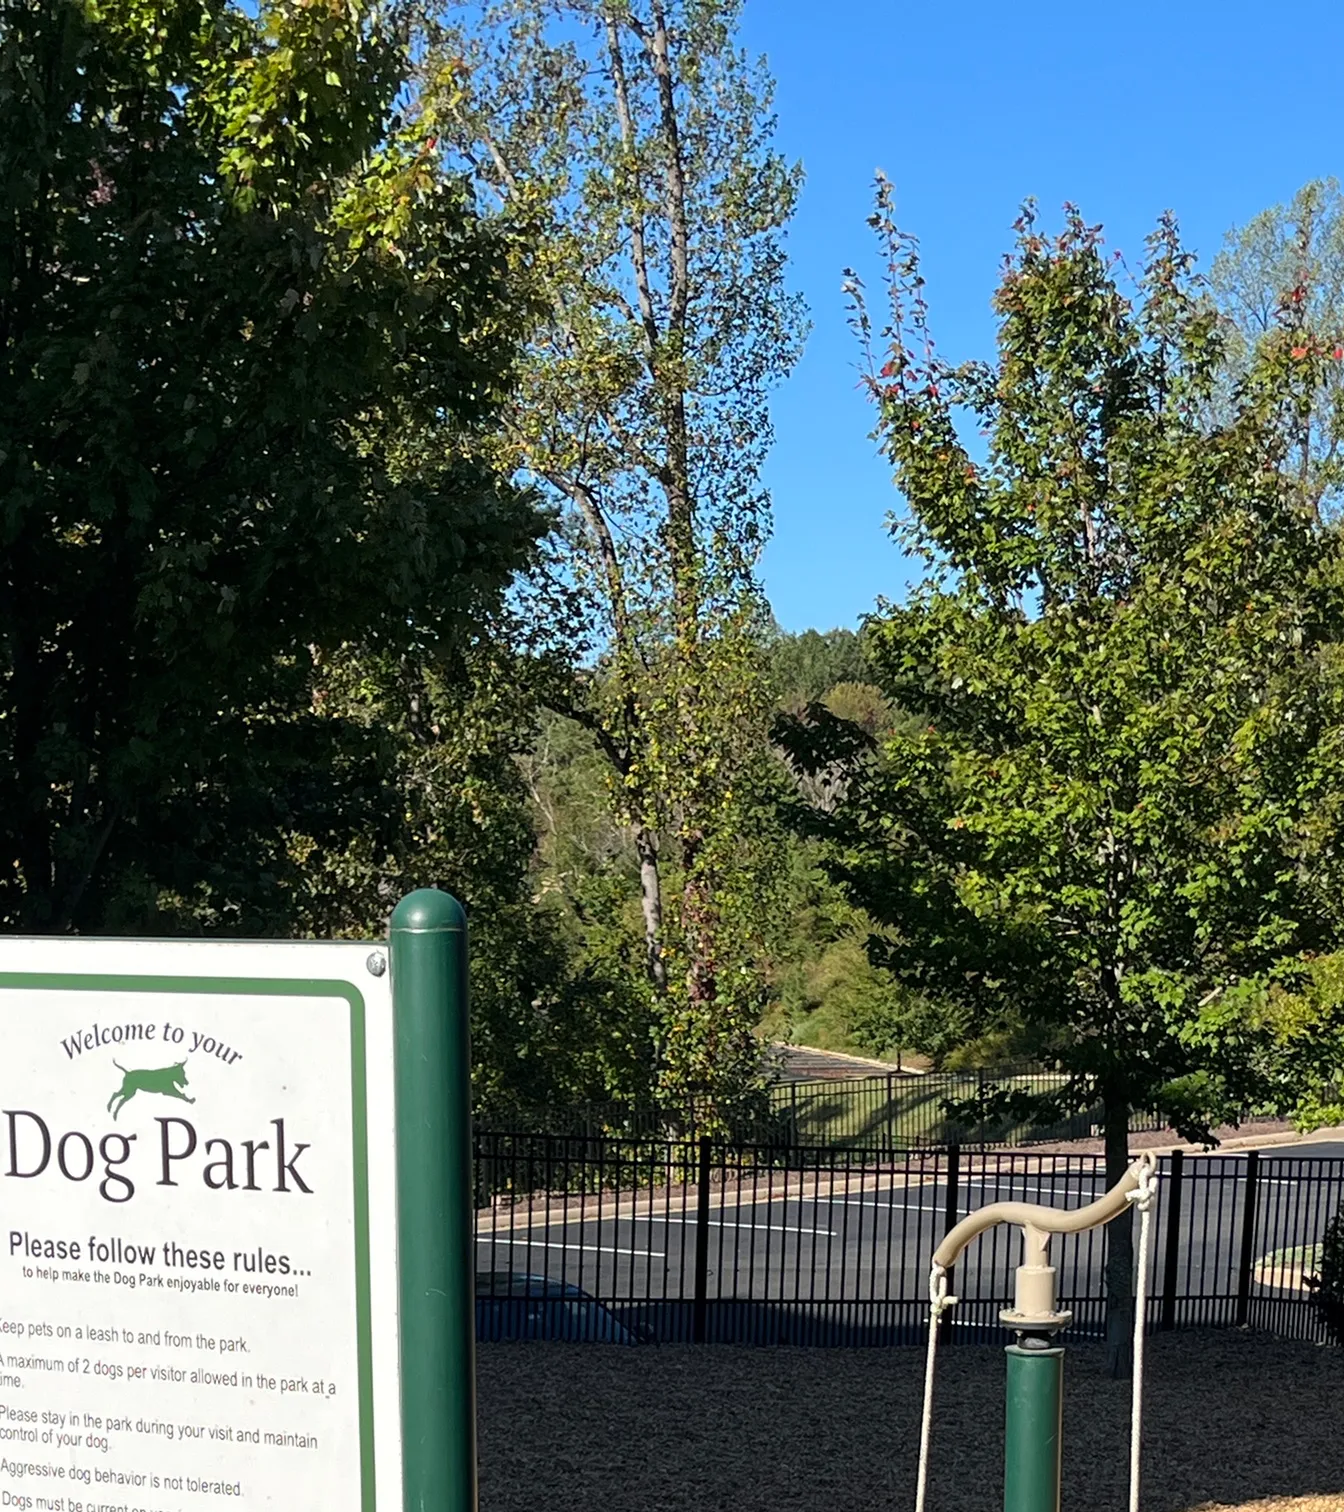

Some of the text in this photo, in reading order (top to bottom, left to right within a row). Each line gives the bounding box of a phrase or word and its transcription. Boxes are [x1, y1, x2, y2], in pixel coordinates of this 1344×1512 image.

[60, 1021, 243, 1066] Welcome to your
[1, 1109, 314, 1203] Dog Park
[9, 1230, 311, 1276] Please follow these rules...
[22, 1265, 298, 1298] to help make the Dog Park enjoyable for everyone!
[27, 1321, 53, 1338] pets
[56, 1325, 71, 1338] on
[74, 1327, 82, 1339] a
[86, 1324, 118, 1342] leash
[121, 1327, 134, 1343] to
[137, 1330, 160, 1345] and
[163, 1330, 192, 1348] from
[195, 1333, 215, 1350] the
[219, 1336, 250, 1354] park.
[6, 1354, 64, 1372] maximum
[67, 1357, 79, 1373] of
[82, 1357, 90, 1374] 2
[93, 1359, 123, 1380] dogs
[126, 1365, 147, 1381] per
[149, 1364, 187, 1382] visitor
[189, 1367, 237, 1386] allowed
[241, 1371, 252, 1387] in
[255, 1373, 276, 1390] the
[280, 1376, 308, 1394] park
[311, 1378, 324, 1394] at
[327, 1382, 336, 1395] a
[0, 1457, 244, 1496] Aggressive dog behavior is not tolerated.
